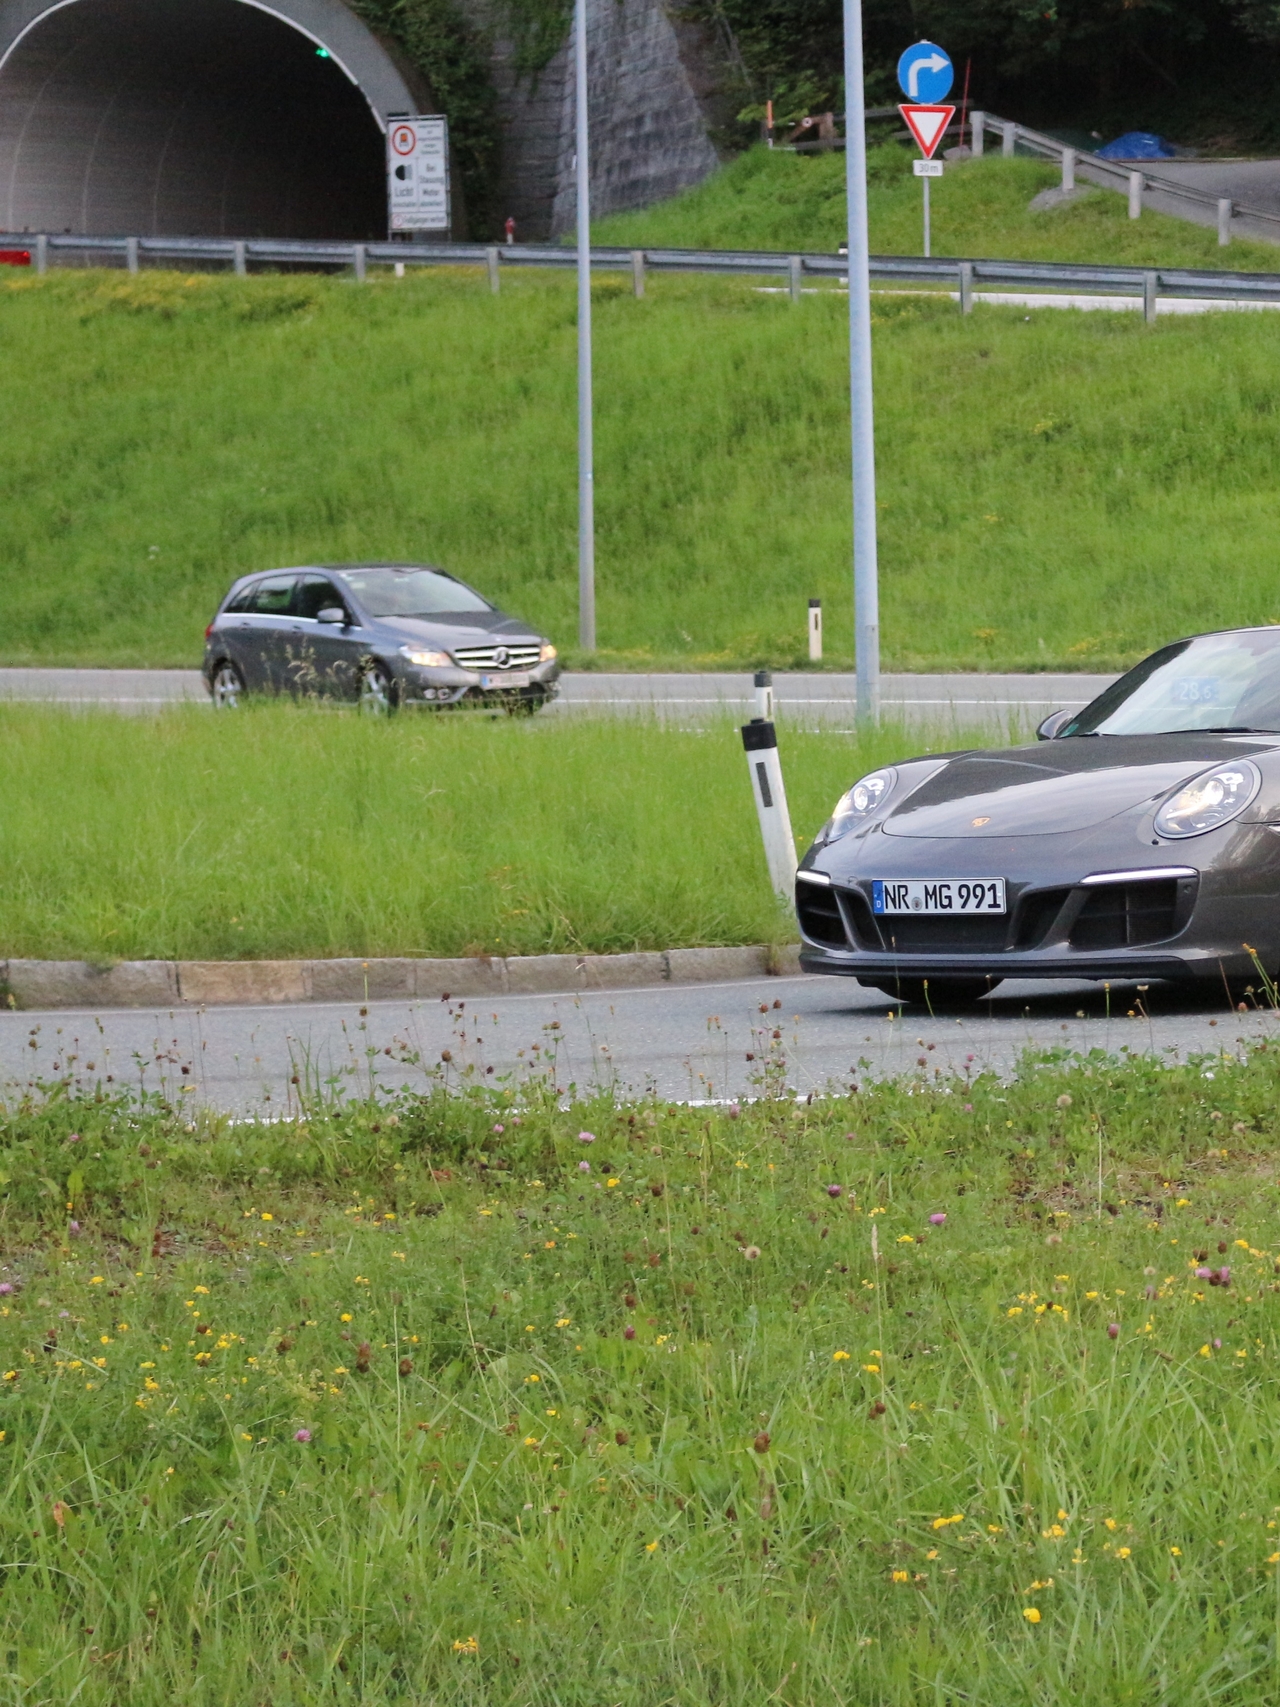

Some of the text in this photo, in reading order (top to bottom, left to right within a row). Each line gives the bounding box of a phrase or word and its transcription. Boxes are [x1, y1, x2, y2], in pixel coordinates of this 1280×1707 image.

[919, 163, 939, 173] 30 m
[884, 883, 1001, 910] NR MG 991
